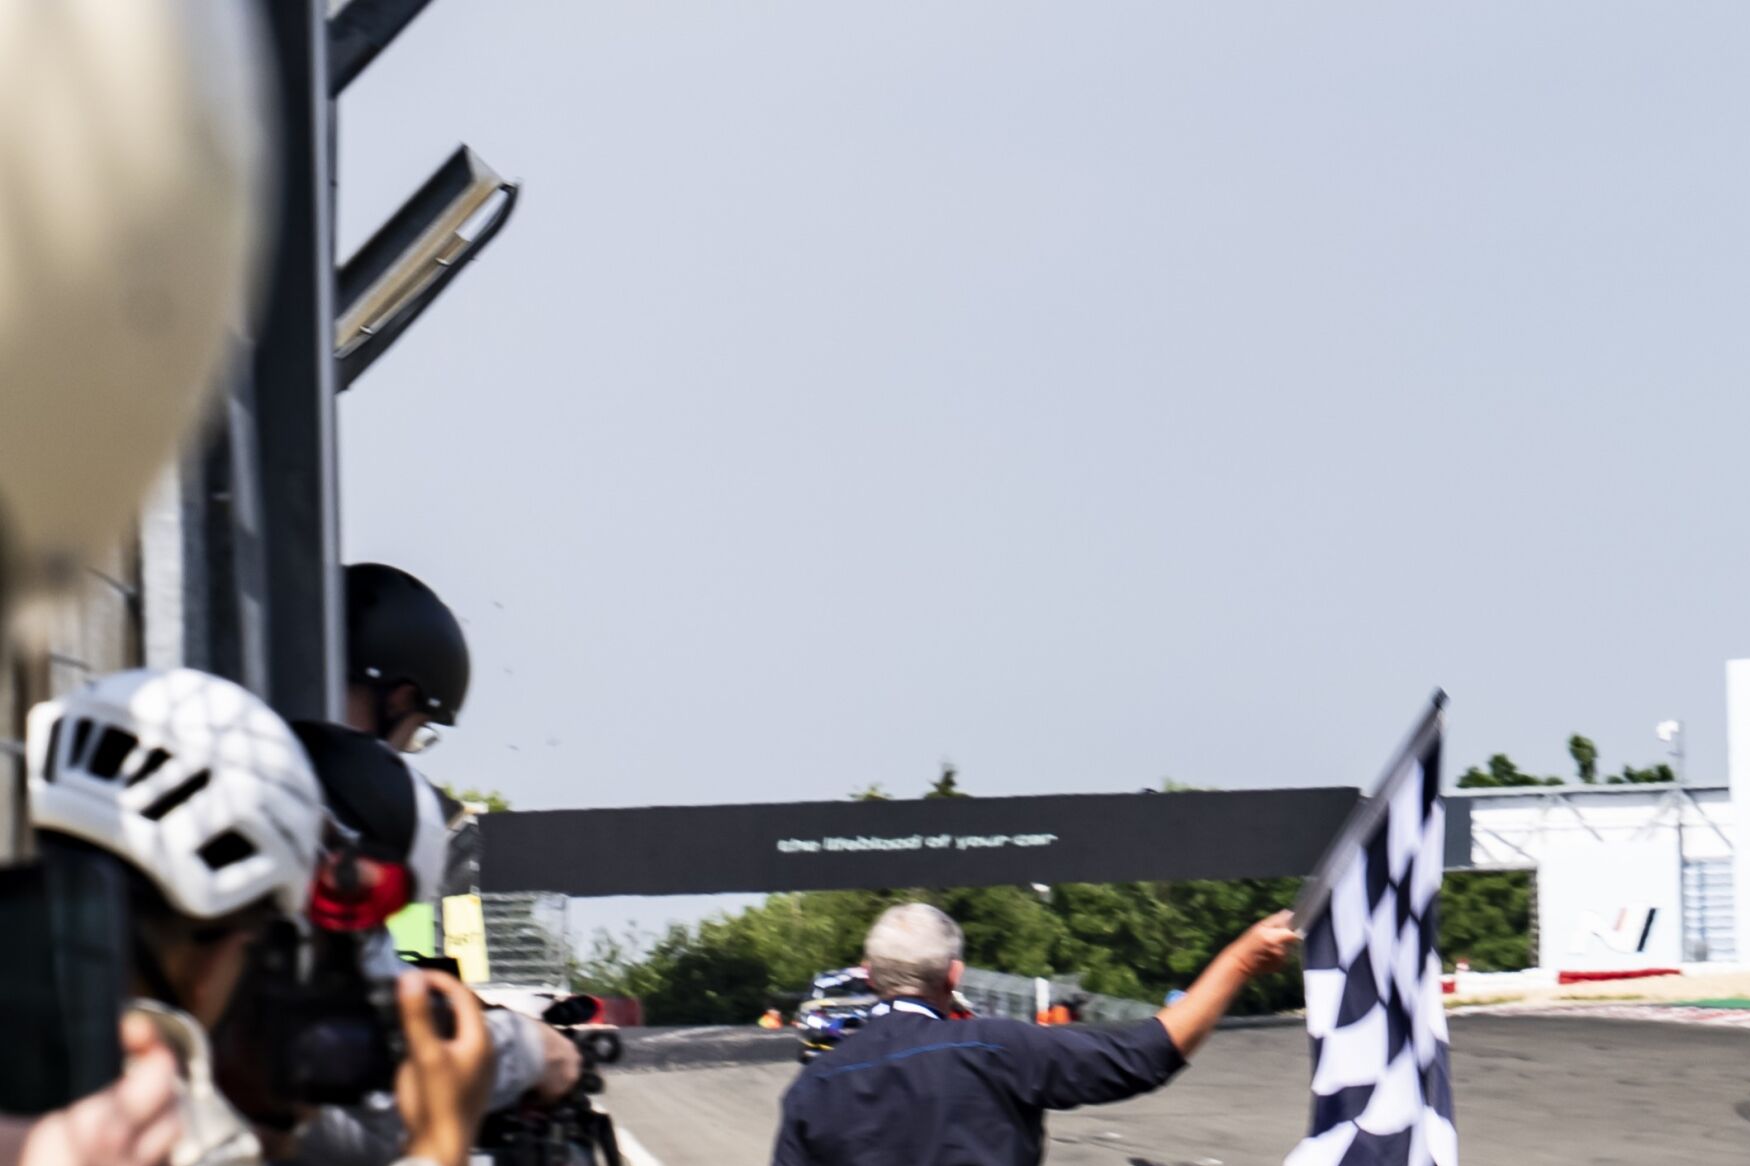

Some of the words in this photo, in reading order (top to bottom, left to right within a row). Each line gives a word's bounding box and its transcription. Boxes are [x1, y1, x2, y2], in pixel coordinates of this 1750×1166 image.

[777, 838, 821, 853] the
[822, 834, 922, 851] lifeblood
[924, 833, 951, 848] of
[955, 834, 1009, 850] your
